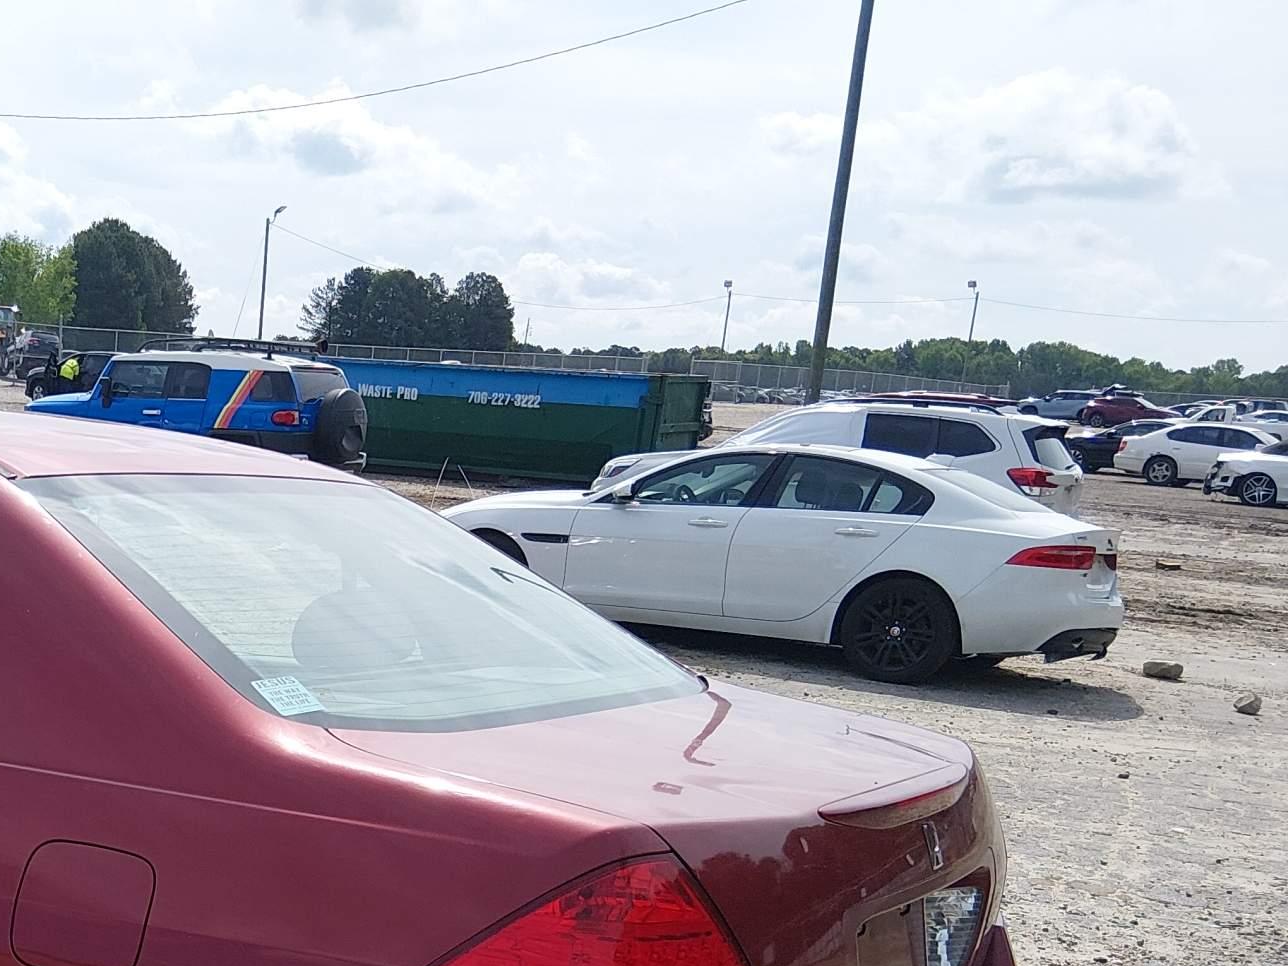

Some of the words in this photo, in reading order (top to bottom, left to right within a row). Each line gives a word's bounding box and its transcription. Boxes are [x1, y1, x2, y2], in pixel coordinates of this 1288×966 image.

[358, 383, 393, 399] WASTE
[396, 386, 418, 401] PRO
[467, 391, 541, 408] 706-227-3222
[255, 675, 296, 689] JESUS
